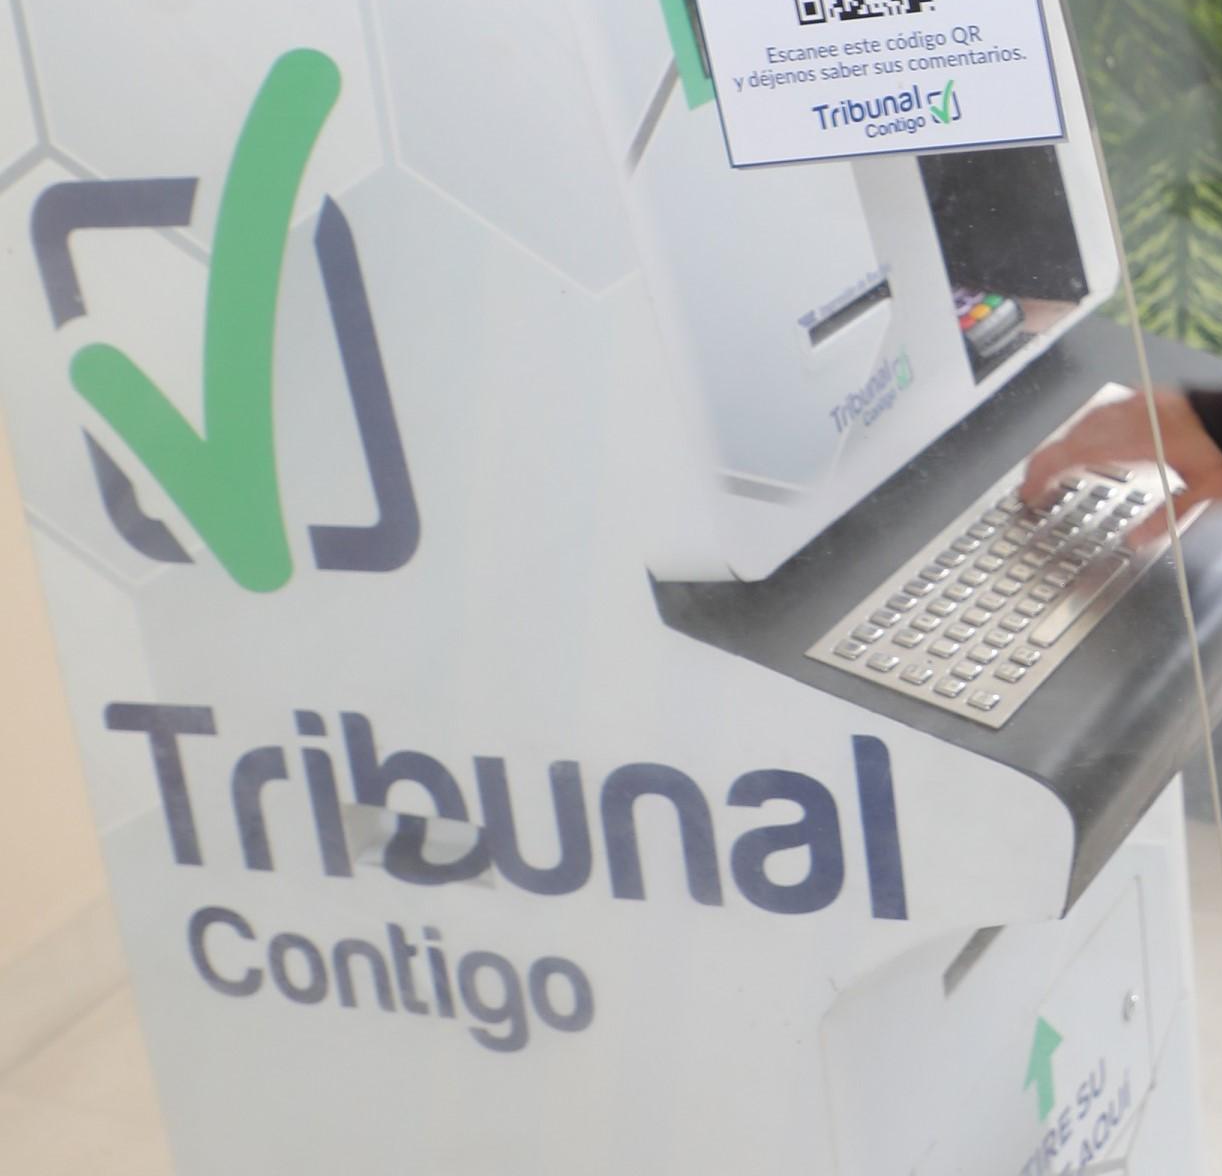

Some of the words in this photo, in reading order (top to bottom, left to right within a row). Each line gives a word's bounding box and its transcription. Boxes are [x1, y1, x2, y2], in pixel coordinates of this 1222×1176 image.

[766, 46, 839, 65] Escanee
[843, 41, 882, 56] este
[886, 31, 947, 51] código
[951, 24, 983, 46] QR
[733, 76, 745, 93] y
[749, 67, 817, 90] déjenos
[820, 61, 870, 80] saber
[873, 59, 904, 75] sus
[908, 46, 1027, 72] comentarios.
[812, 84, 922, 131] Tribunal
[865, 114, 927, 139] Contigo
[104, 701, 909, 922] Tribunal
[187, 904, 595, 1054] Contigo
